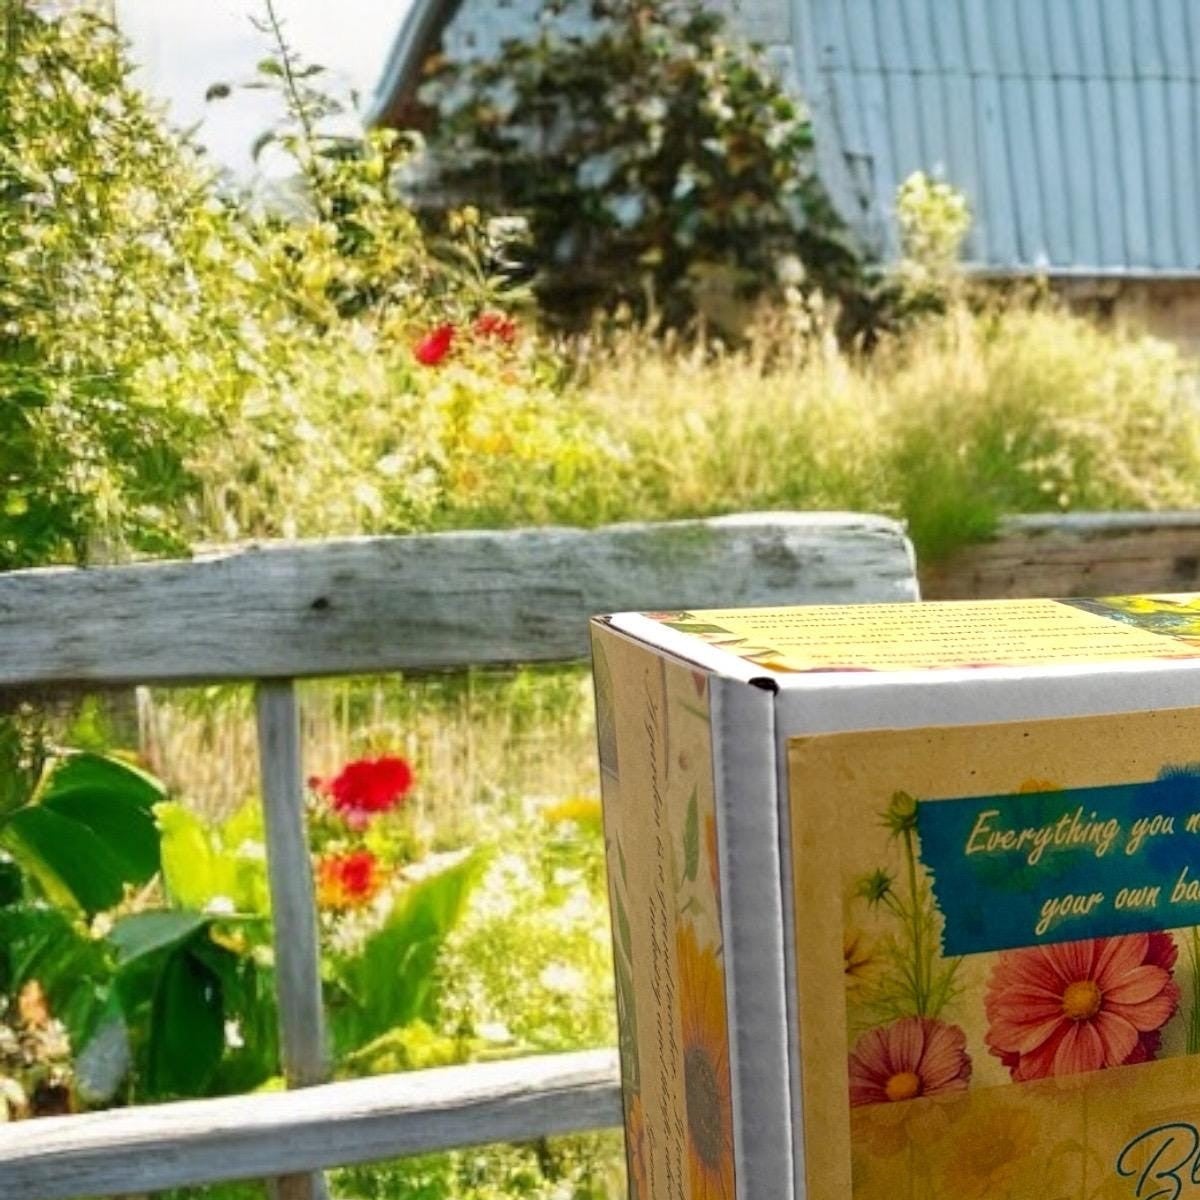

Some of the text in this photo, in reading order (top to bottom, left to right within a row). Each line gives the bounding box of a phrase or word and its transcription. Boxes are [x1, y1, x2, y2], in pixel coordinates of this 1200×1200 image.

[965, 810, 1119, 865] Everything
[1126, 815, 1174, 854] you
[1035, 892, 1103, 935] your
[1115, 884, 1158, 909] own
